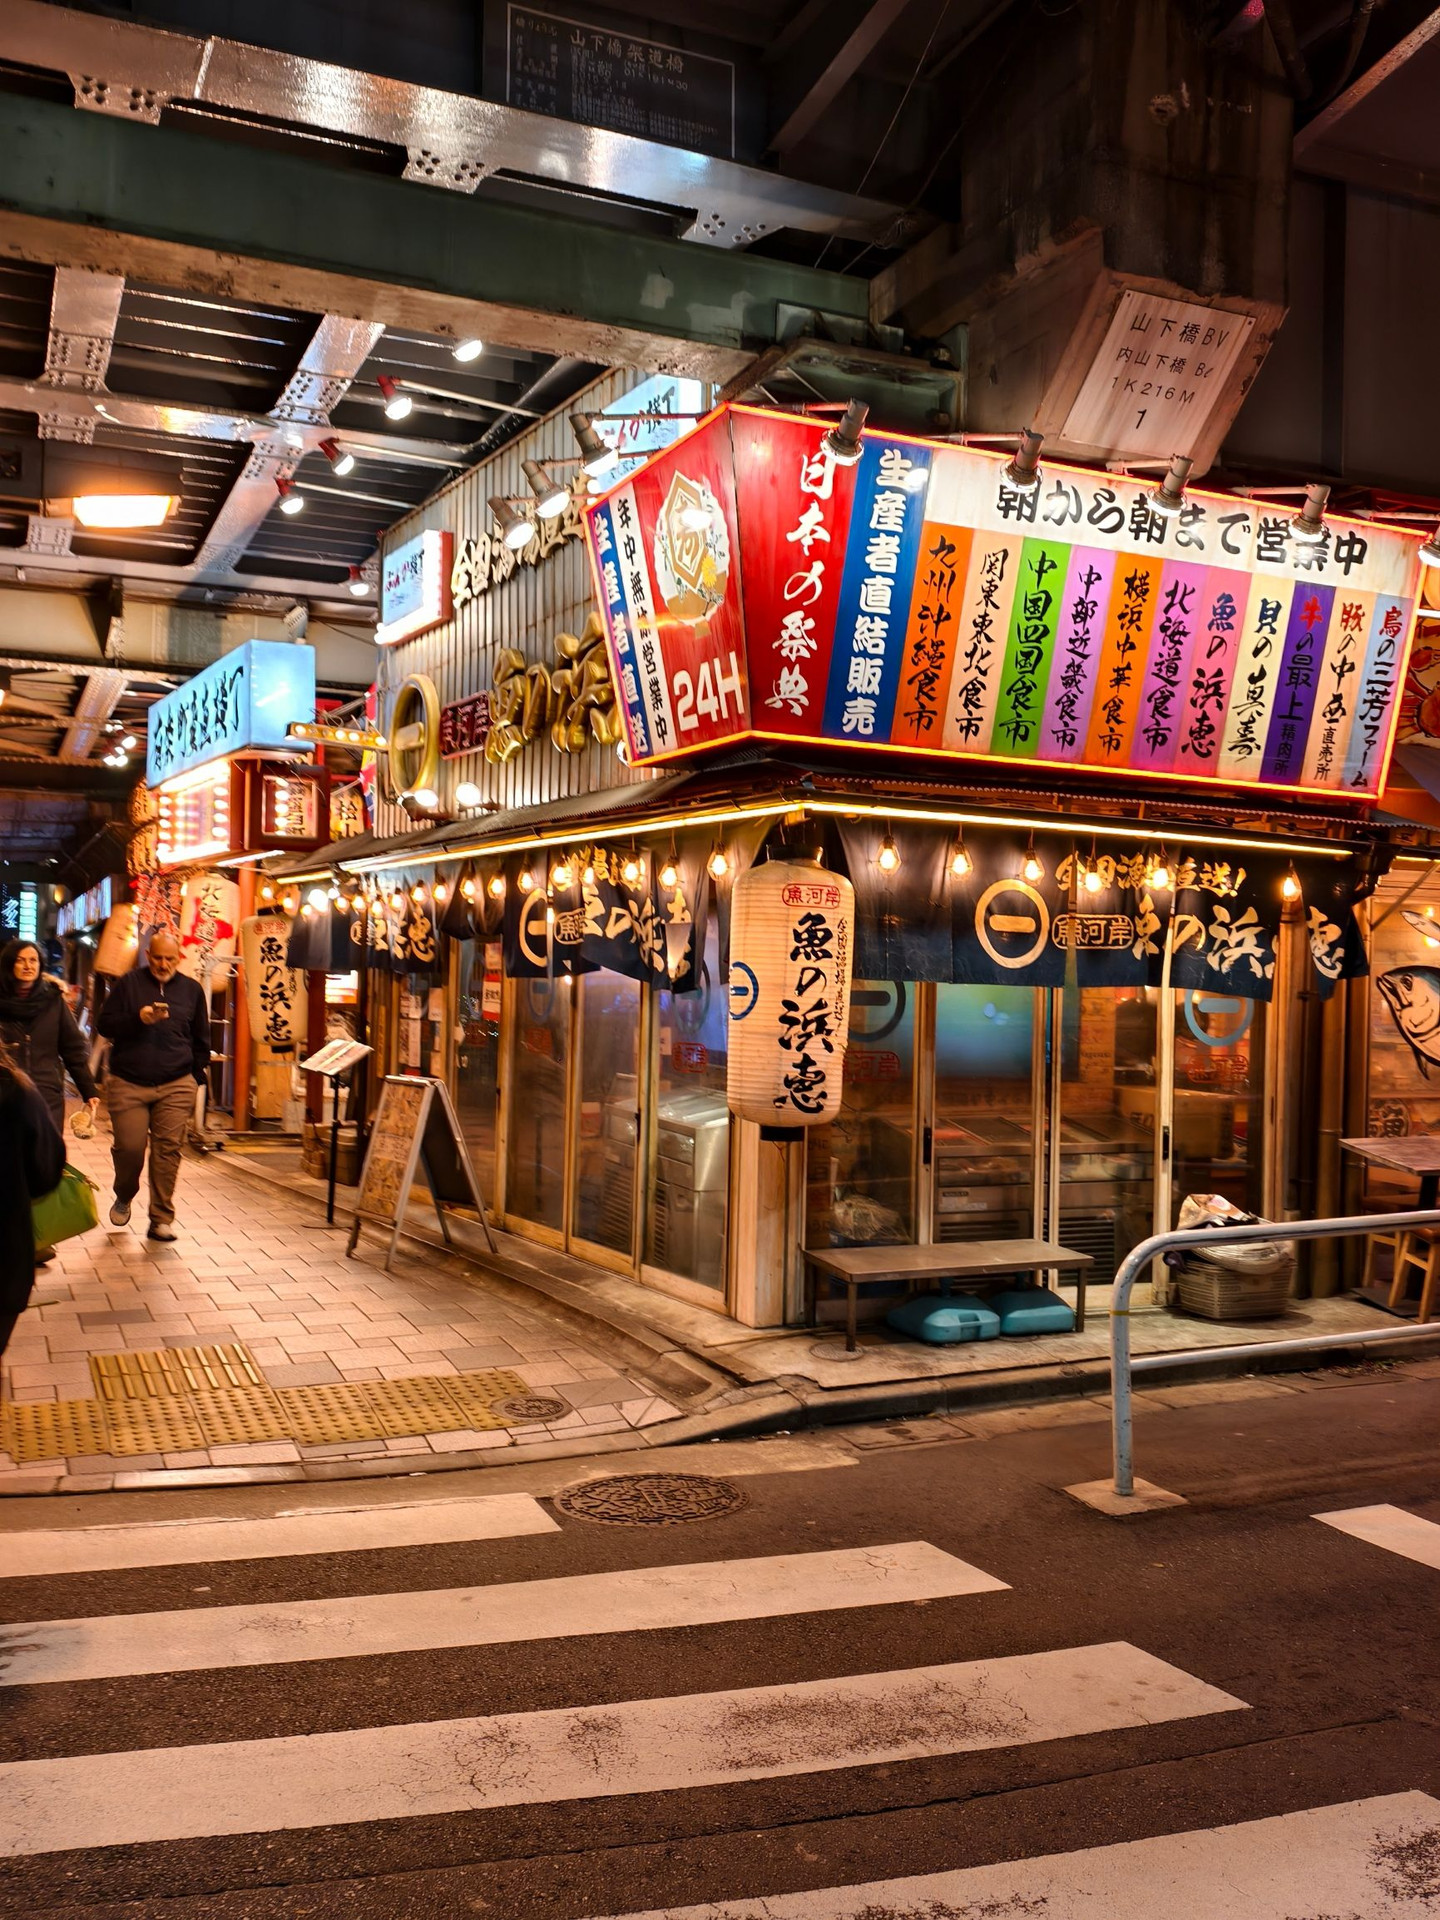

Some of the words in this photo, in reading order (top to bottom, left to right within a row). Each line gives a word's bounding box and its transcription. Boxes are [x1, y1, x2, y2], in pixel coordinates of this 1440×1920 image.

[570, 29, 684, 73] 山下橋架道橋
[1115, 346, 1187, 375] 内山下橋
[1135, 409, 1148, 429] 1
[764, 452, 837, 716] 日本の祭典
[842, 449, 914, 736] 生産者直結販売
[996, 479, 1369, 576] 朝から朝まで営業中
[673, 651, 745, 732] 24H
[904, 535, 958, 741] 九州沖縄食市
[956, 548, 1009, 743] 関東東北食市
[999, 551, 1057, 749] 中国四国食市
[1051, 564, 1102, 752] 中部近畿食市
[1099, 568, 1151, 756] 横浜中華食市
[1142, 579, 1196, 757] 北海道食市
[1181, 592, 1237, 759] 魚の浜恵
[786, 885, 840, 906] 魚河岸
[1055, 850, 1247, 897] 全国漁直送!
[260, 937, 292, 1042] 魚の浜恵
[772, 911, 834, 1114] 魚の浜恵
